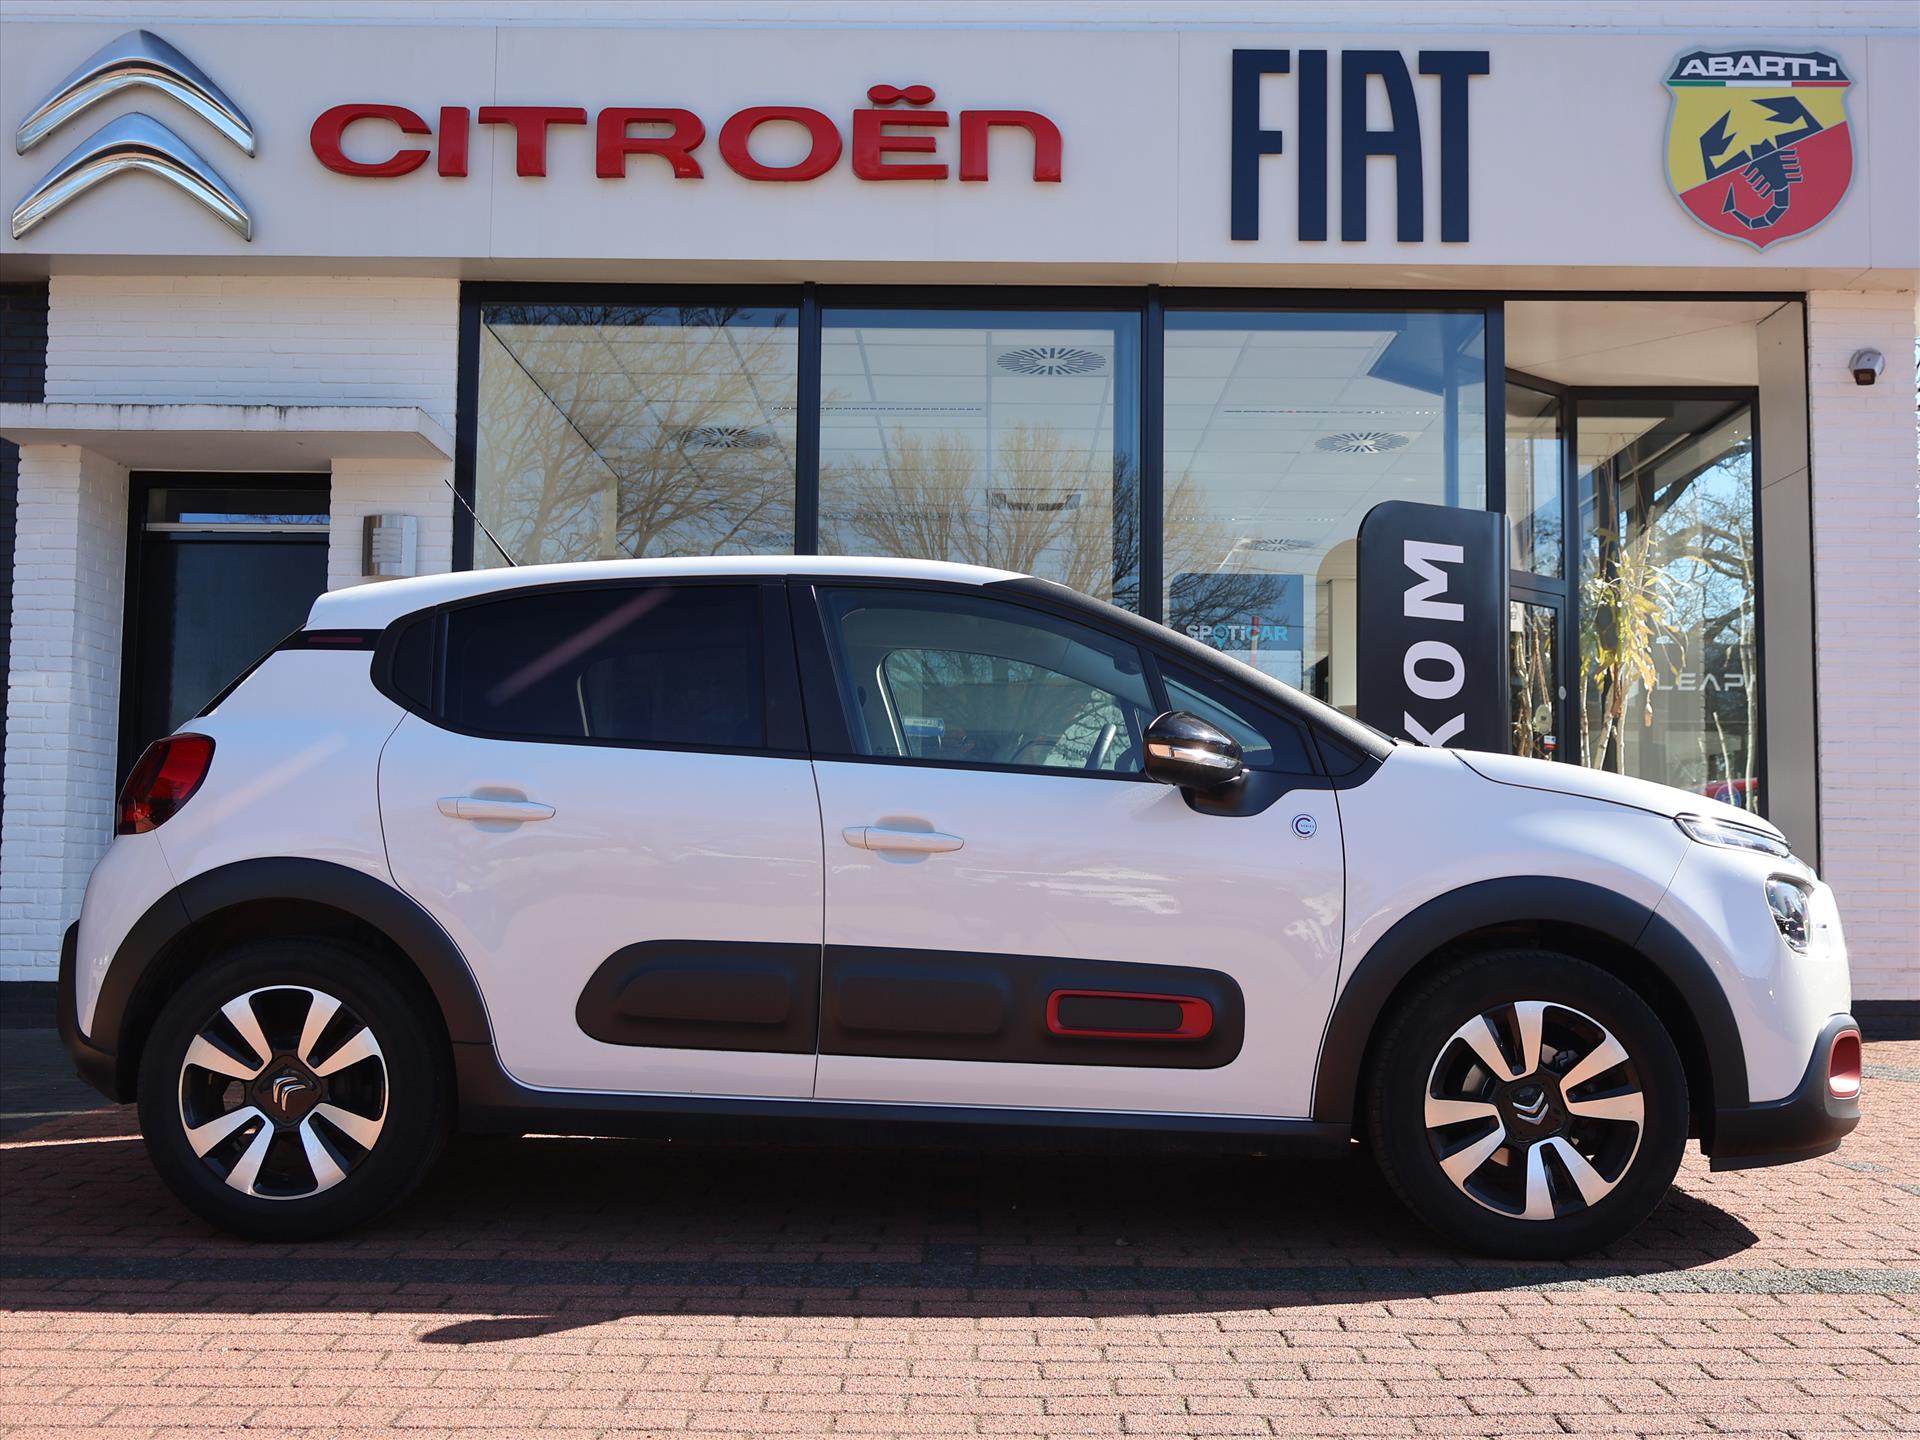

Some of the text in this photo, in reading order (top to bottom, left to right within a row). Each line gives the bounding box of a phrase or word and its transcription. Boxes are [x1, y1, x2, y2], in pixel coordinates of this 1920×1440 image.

[1681, 56, 1837, 77] ABARTH
[1231, 49, 1490, 242] FIAT
[1655, 673, 1746, 691] LEAP
